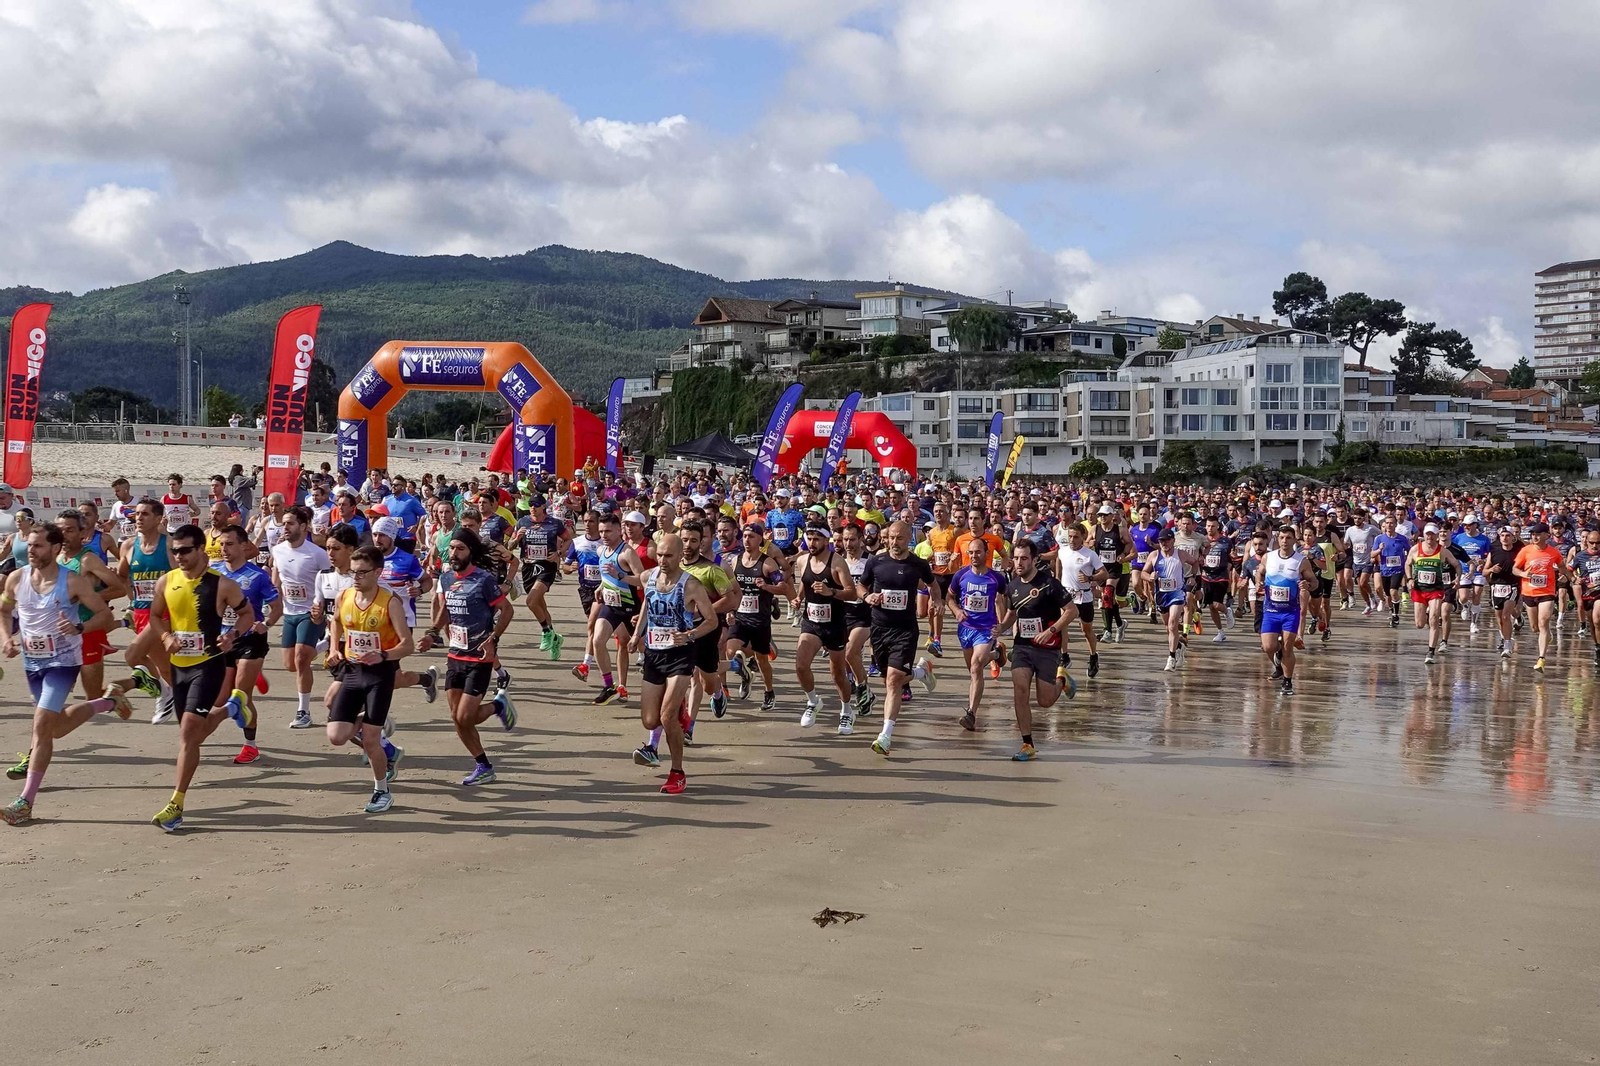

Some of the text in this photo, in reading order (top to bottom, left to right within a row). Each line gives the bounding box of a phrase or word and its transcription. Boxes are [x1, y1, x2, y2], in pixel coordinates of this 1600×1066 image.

[27, 328, 46, 381] VIGO
[421, 354, 478, 377] FE seguros
[287, 334, 314, 434] RUN VIGO
[362, 371, 376, 388] FE
[363, 377, 384, 397] seguros
[512, 379, 527, 398] FE
[10, 374, 26, 420] RUN
[505, 385, 524, 407] seguros
[270, 384, 290, 433] RUN
[607, 424, 618, 442] FE
[763, 402, 791, 451] FE seguros
[829, 408, 852, 453] FE seguros
[342, 443, 359, 467] FE
[528, 450, 546, 474] FE
[886, 596, 902, 604] 285
[180, 640, 195, 649] 33
[354, 639, 372, 647] 694
[655, 634, 670, 642] 277
